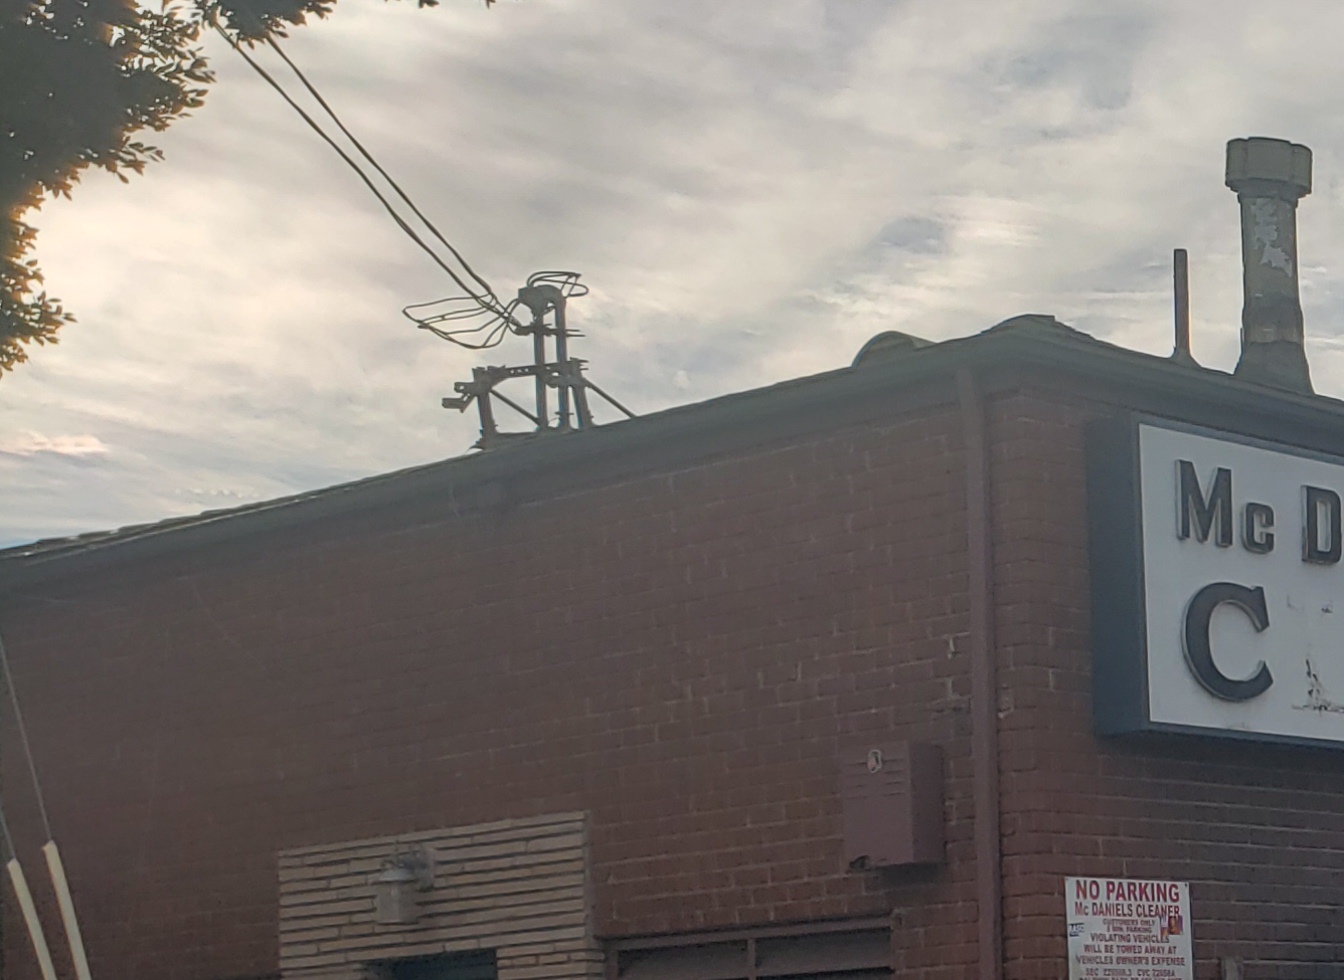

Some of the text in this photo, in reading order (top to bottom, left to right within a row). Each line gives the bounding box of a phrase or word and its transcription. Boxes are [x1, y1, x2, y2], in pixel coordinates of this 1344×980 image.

[1075, 879, 1180, 903] NO PARKING
[1091, 902, 1133, 918] DANIELS
[1090, 932, 1171, 944] VIOLATING VEHICLES
[1083, 944, 1178, 955] WILL BE TOWED AWAY AT
[1075, 955, 1114, 966] VEHICLES
[1151, 957, 1186, 967] EXPENSE
